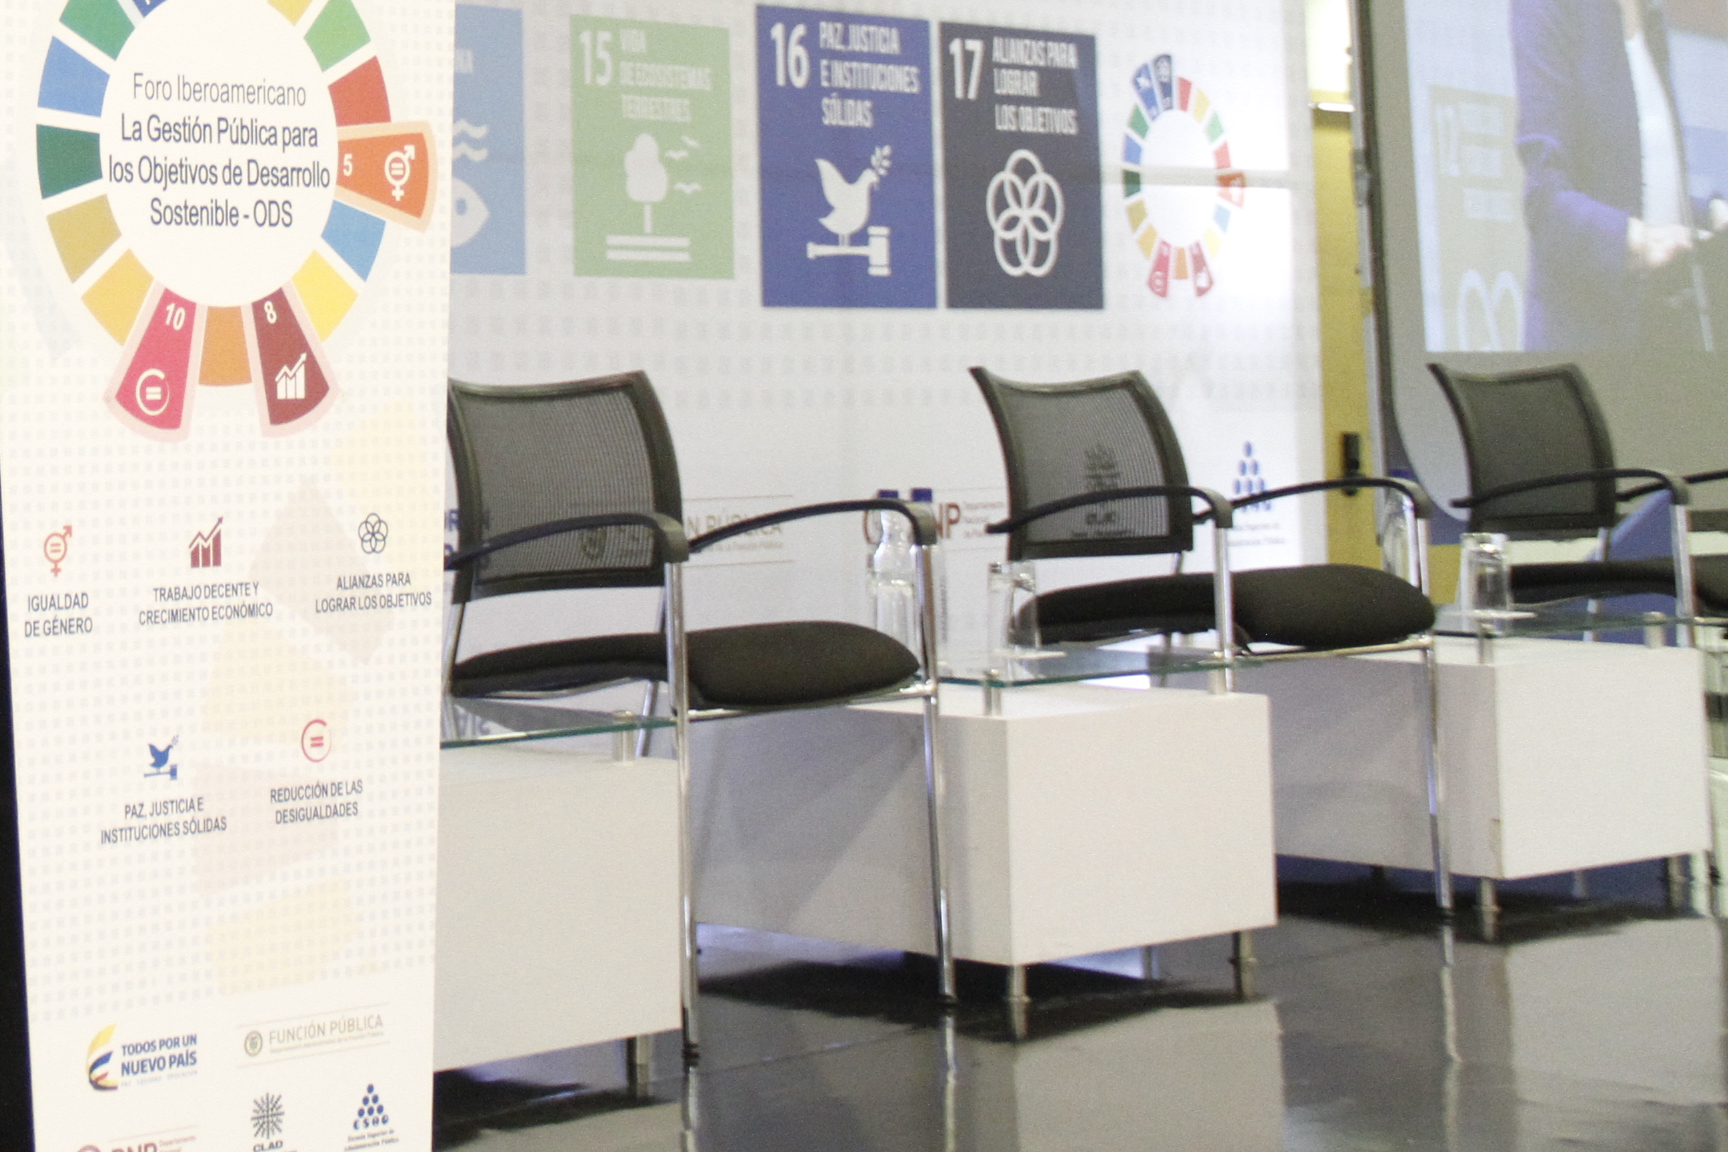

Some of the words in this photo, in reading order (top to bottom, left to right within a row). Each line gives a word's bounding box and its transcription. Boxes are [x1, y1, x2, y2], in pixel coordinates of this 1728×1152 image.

[847, 24, 901, 55] JUSTICIA
[992, 36, 1046, 67] ALIANZAS
[1046, 41, 1079, 70] PARA
[580, 30, 613, 86] 15
[770, 22, 810, 88] 16
[949, 38, 985, 100] 17
[133, 72, 172, 101] Foro
[177, 74, 307, 106] Iberoamericano
[820, 59, 830, 87] E
[831, 60, 920, 94] INSTITUCIONES
[994, 68, 1040, 97] LOGRAR
[822, 92, 873, 128] SÓLIDAS
[994, 104, 1018, 131] LOS
[1018, 105, 1079, 135] OBJETIVOS
[121, 113, 142, 141] La
[147, 114, 212, 143] Gestión
[217, 117, 277, 146] Pública
[282, 125, 318, 153] para
[109, 154, 134, 183] los
[138, 155, 218, 191] Objetivos
[222, 159, 242, 185] de
[247, 159, 331, 188] Desarrollo
[342, 153, 354, 177] 5
[150, 197, 239, 227] Sostenible
[253, 200, 293, 228] ODS
[165, 302, 186, 331] 10
[264, 300, 277, 324] 8
[153, 586, 202, 602] TRABAJO
[203, 583, 251, 599] DECENTE
[252, 582, 259, 596] Y
[336, 573, 384, 590] ALIANZAS
[385, 572, 412, 587] PARA
[28, 592, 89, 612] IGUALDAD
[139, 606, 210, 626] CRECIMIENTO
[212, 600, 273, 620] ECONÓMICO
[315, 596, 357, 613] LOGRAR
[358, 595, 378, 610] LOS
[379, 591, 432, 609] OBJETIVOS
[24, 620, 40, 638] DE
[43, 615, 93, 636] GÉNERO
[270, 780, 328, 804] REDUCCIÓN
[330, 781, 343, 797] DE
[345, 779, 363, 795] LAS
[124, 802, 147, 820] PAZ,
[149, 798, 196, 817] JUSTICIA
[197, 796, 204, 812] E
[275, 801, 359, 825] DESIGUALDADES
[100, 821, 180, 845] INSTITUCIONES
[182, 816, 228, 836] SÓLIDAS
[269, 1022, 326, 1045] FUNCIÓN
[329, 1013, 384, 1035] PÚBLICA
[121, 1040, 157, 1057] TODOS
[159, 1036, 180, 1051] POR
[182, 1033, 198, 1047] UN
[121, 1055, 166, 1077] NUEVO
[169, 1048, 198, 1069] PAÍS
